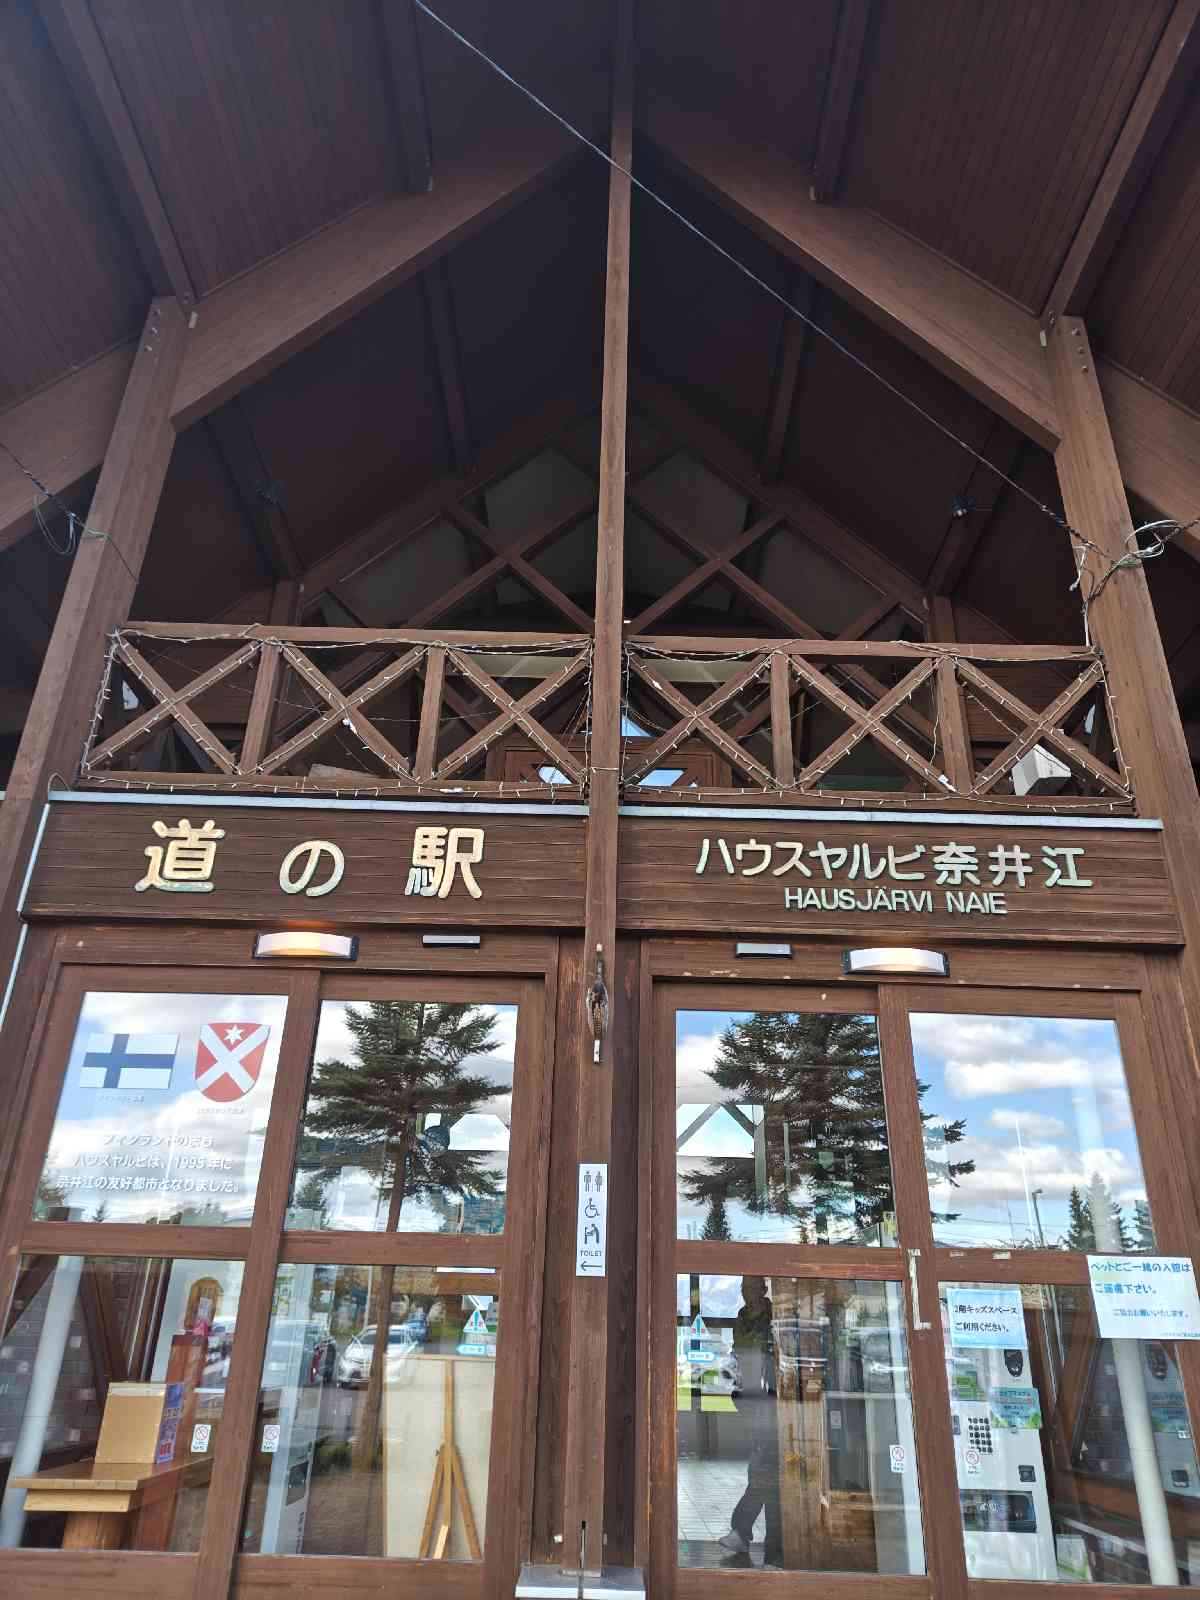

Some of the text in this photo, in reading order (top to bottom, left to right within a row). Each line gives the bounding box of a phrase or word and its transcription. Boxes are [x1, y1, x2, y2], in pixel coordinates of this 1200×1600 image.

[134, 818, 486, 899] 道の駅
[695, 838, 1094, 888] ハウスヤルビ奈井江
[784, 886, 1008, 915] HAUSJÄRVI NAIE
